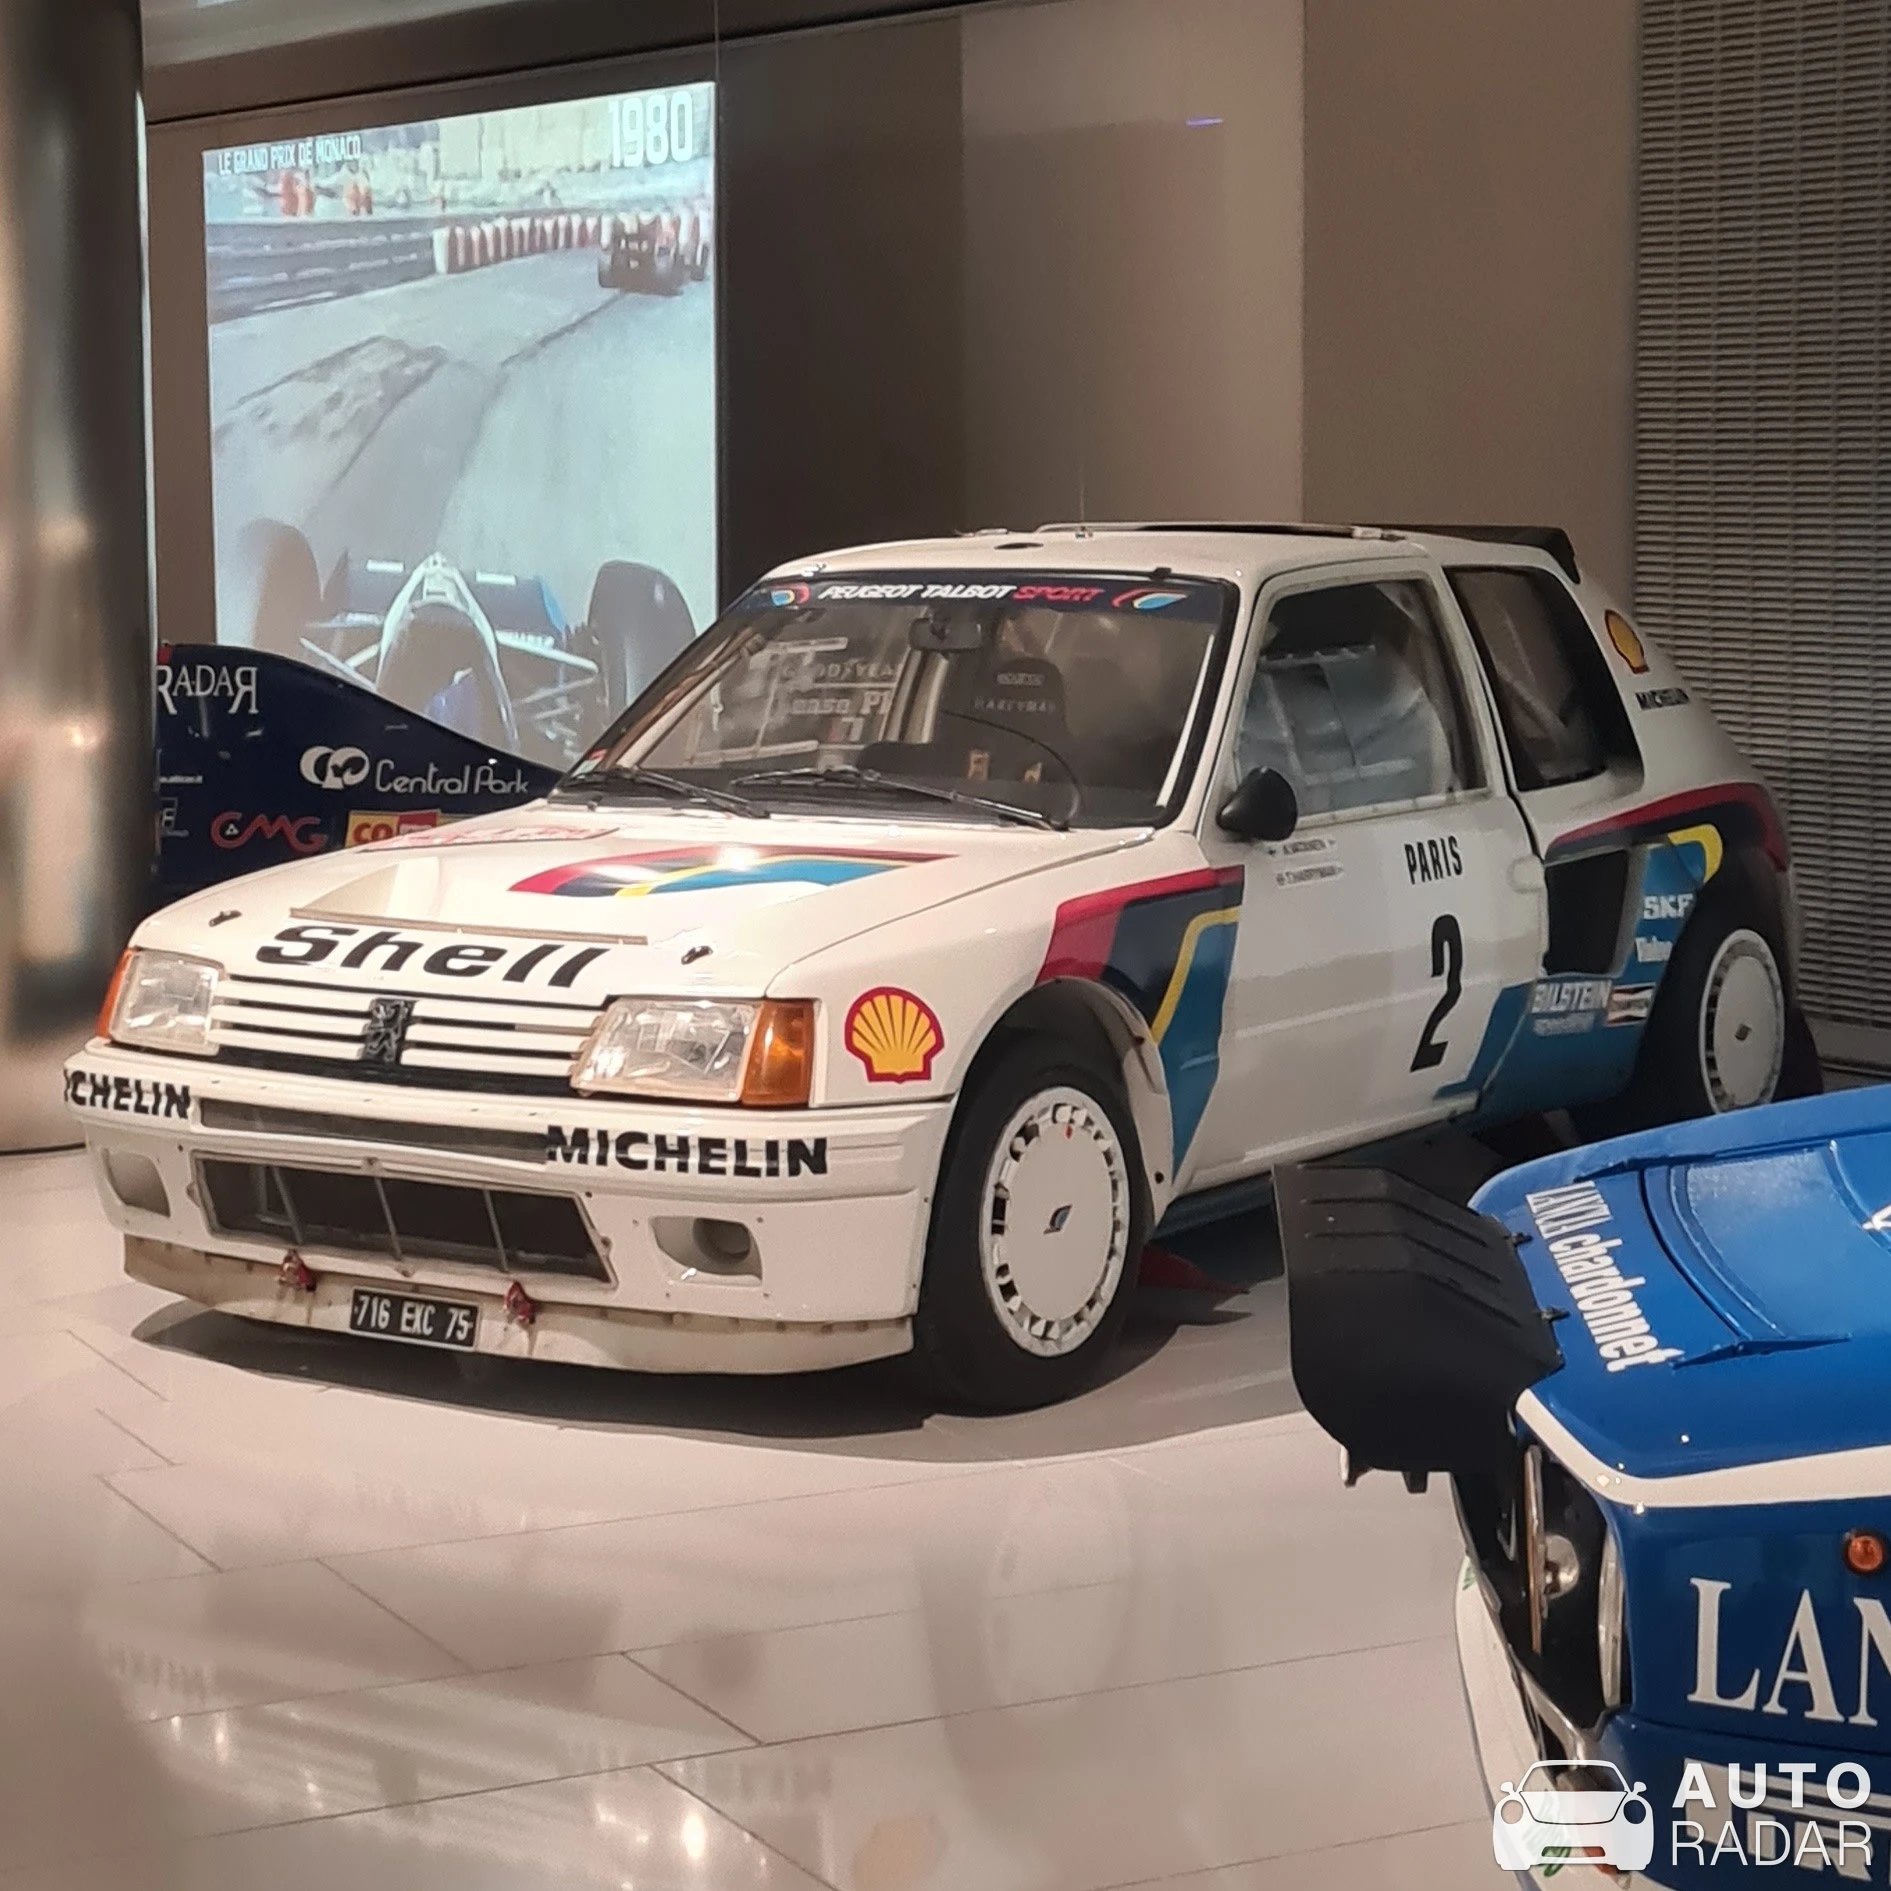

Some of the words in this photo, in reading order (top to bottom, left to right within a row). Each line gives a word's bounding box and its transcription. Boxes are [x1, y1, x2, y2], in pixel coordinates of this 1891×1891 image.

[608, 91, 693, 168] 1980
[218, 152, 231, 176] LE
[233, 148, 269, 174] GRAND
[270, 143, 297, 169] PRIX
[298, 141, 314, 166] DE
[315, 134, 362, 164] MONACO
[818, 584, 924, 600] PEUGEOT
[920, 584, 1017, 600] TALBOT
[1013, 586, 1104, 601] SPORT
[375, 759, 470, 795] Central
[473, 765, 528, 795] Park
[1404, 835, 1464, 885] PARIS
[1643, 893, 1694, 920] SKF
[255, 925, 612, 988] Shell
[1410, 914, 1463, 1073] 2
[1531, 978, 1613, 1014] BILSTEIN
[547, 1124, 829, 1179] MICHELIN
[356, 1294, 392, 1330] 716
[400, 1300, 437, 1337] EXC
[445, 1307, 473, 1341] 75
[1549, 1233, 1685, 1373] chardonnet
[1687, 1577, 1891, 1727] LAN
